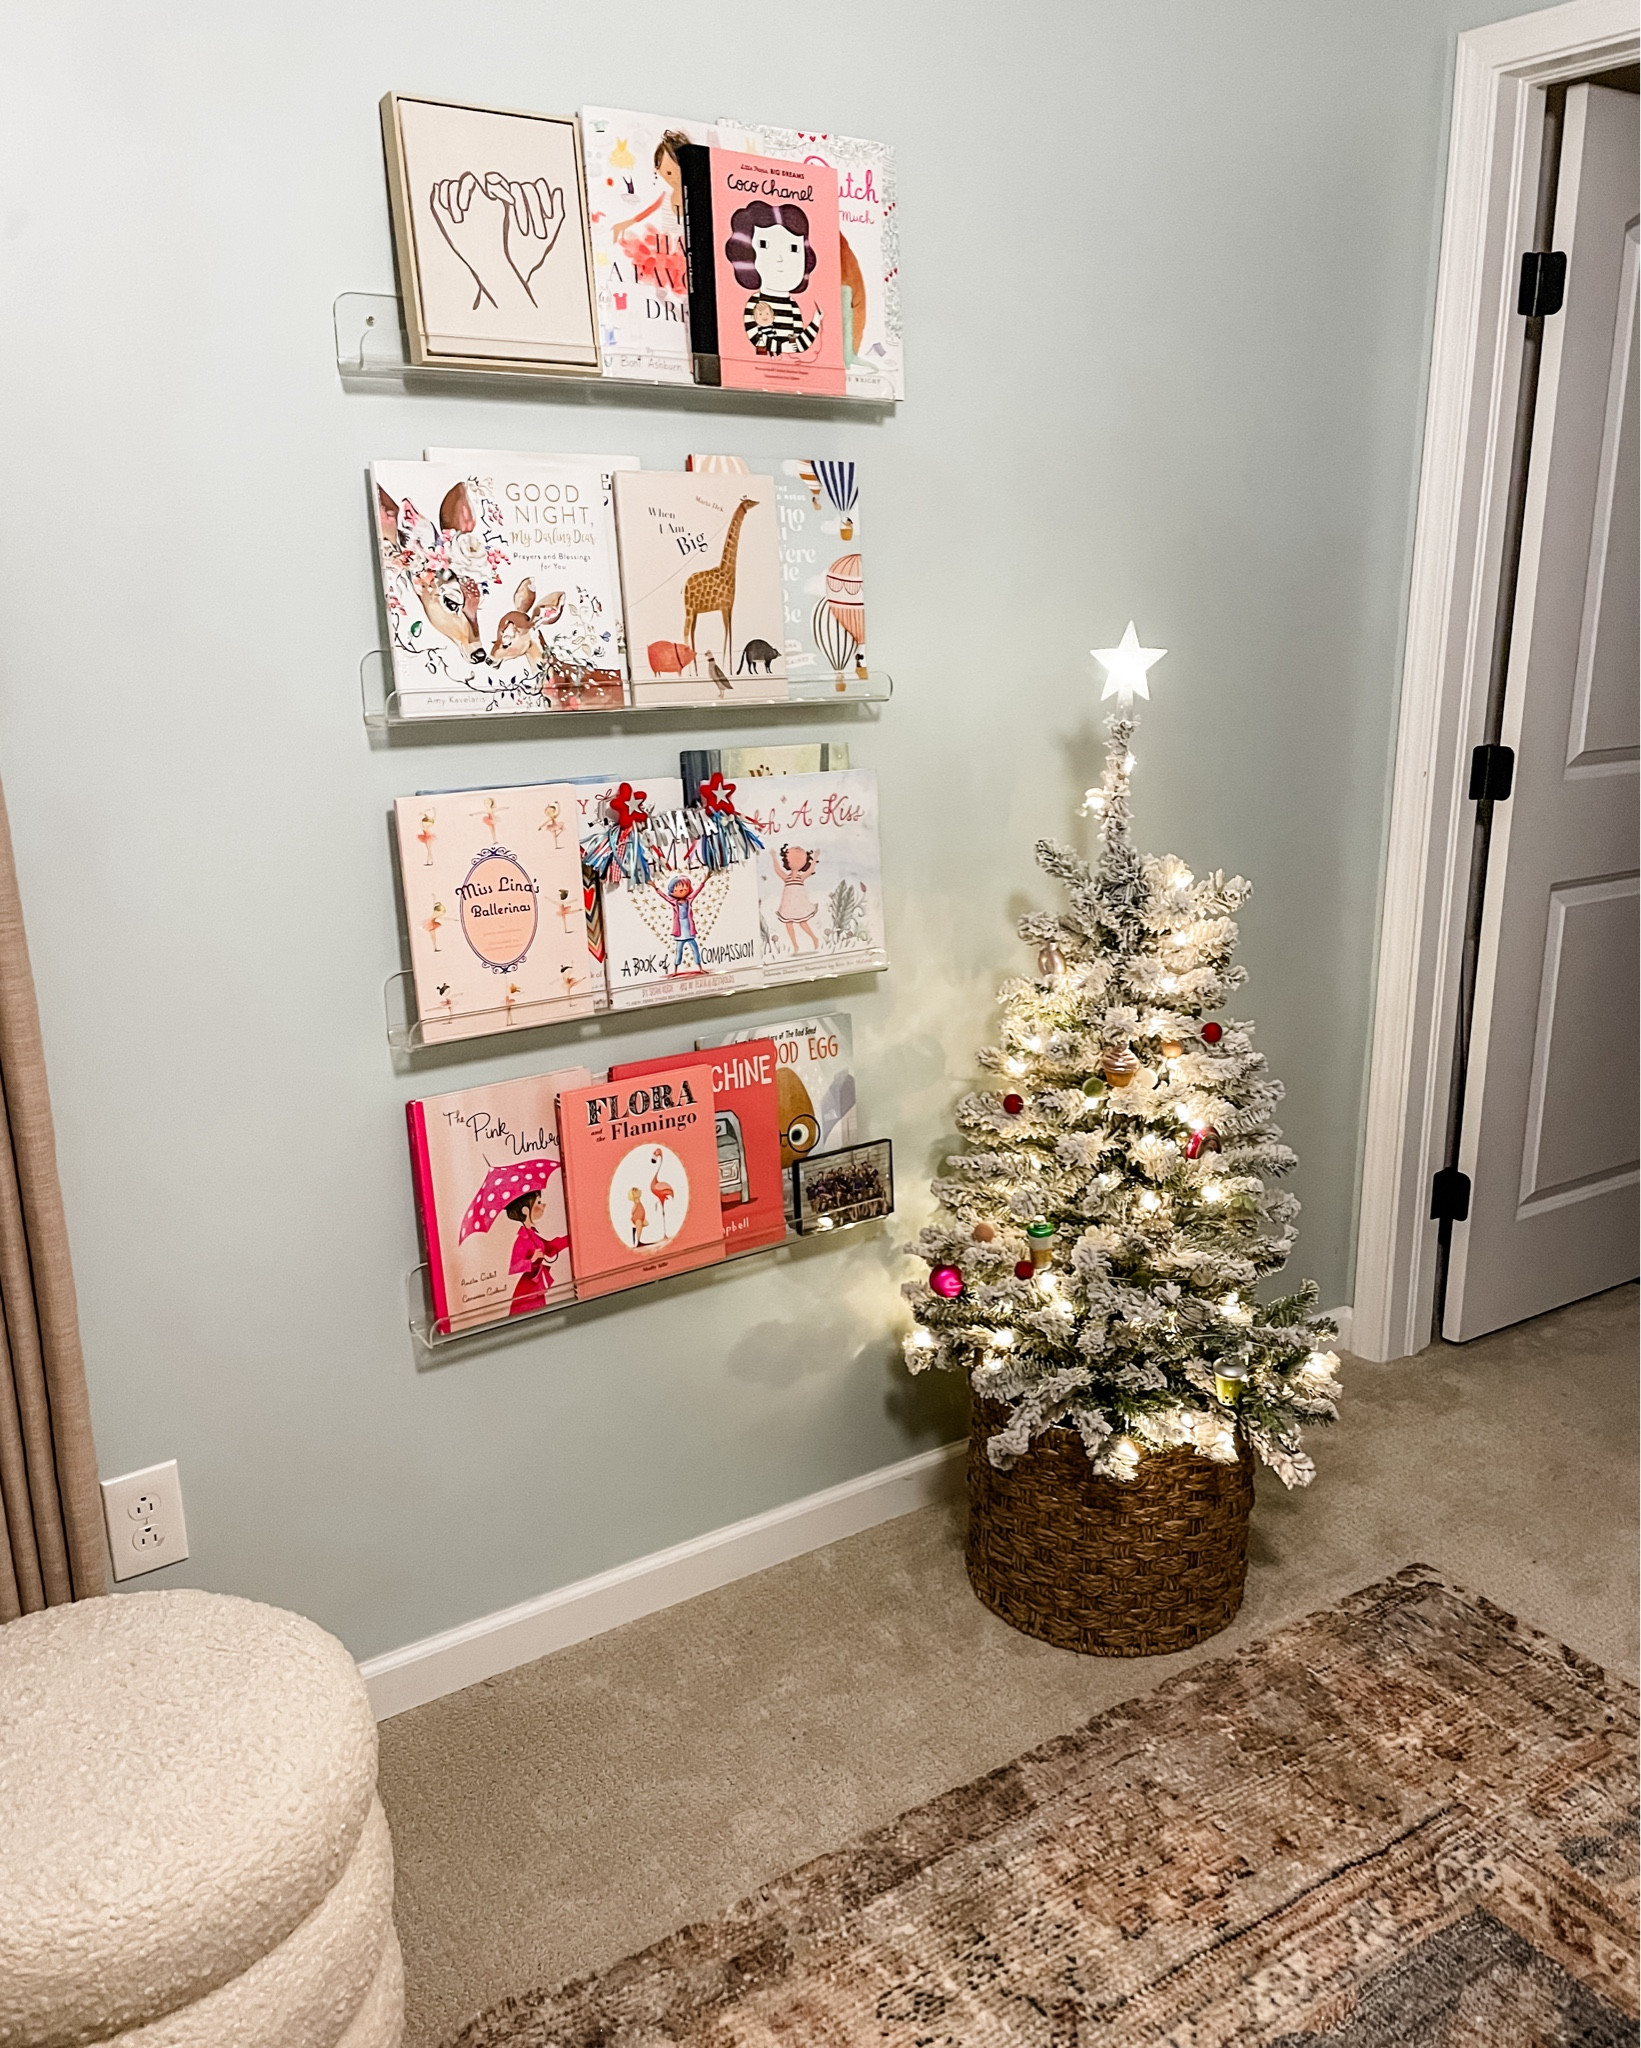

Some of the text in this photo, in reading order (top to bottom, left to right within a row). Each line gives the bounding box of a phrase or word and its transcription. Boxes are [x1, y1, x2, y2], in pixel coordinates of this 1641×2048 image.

[727, 173, 814, 202] Coco Chanel
[505, 483, 579, 502] GOOD
[515, 505, 594, 527] NIGHT,
[648, 506, 676, 519] When
[511, 530, 531, 547] My
[535, 527, 571, 547] Darling
[659, 523, 685, 535] I Am
[676, 532, 709, 556] Big
[513, 552, 541, 562] Prayers
[558, 552, 591, 562] Blessings
[540, 563, 566, 572] for You
[427, 697, 445, 708] Amy
[787, 799, 812, 828] A
[819, 793, 865, 828] Kiss
[455, 876, 539, 900] Miss Lina's
[471, 902, 531, 917] Ballerinas
[621, 939, 754, 977] A BOOK of COMPASSION
[774, 1034, 838, 1064] OD EGG
[711, 1054, 772, 1093] CHINE
[586, 1080, 698, 1127] FLORA
[443, 1109, 509, 1142] The Pink
[611, 1112, 697, 1141] Flamingo
